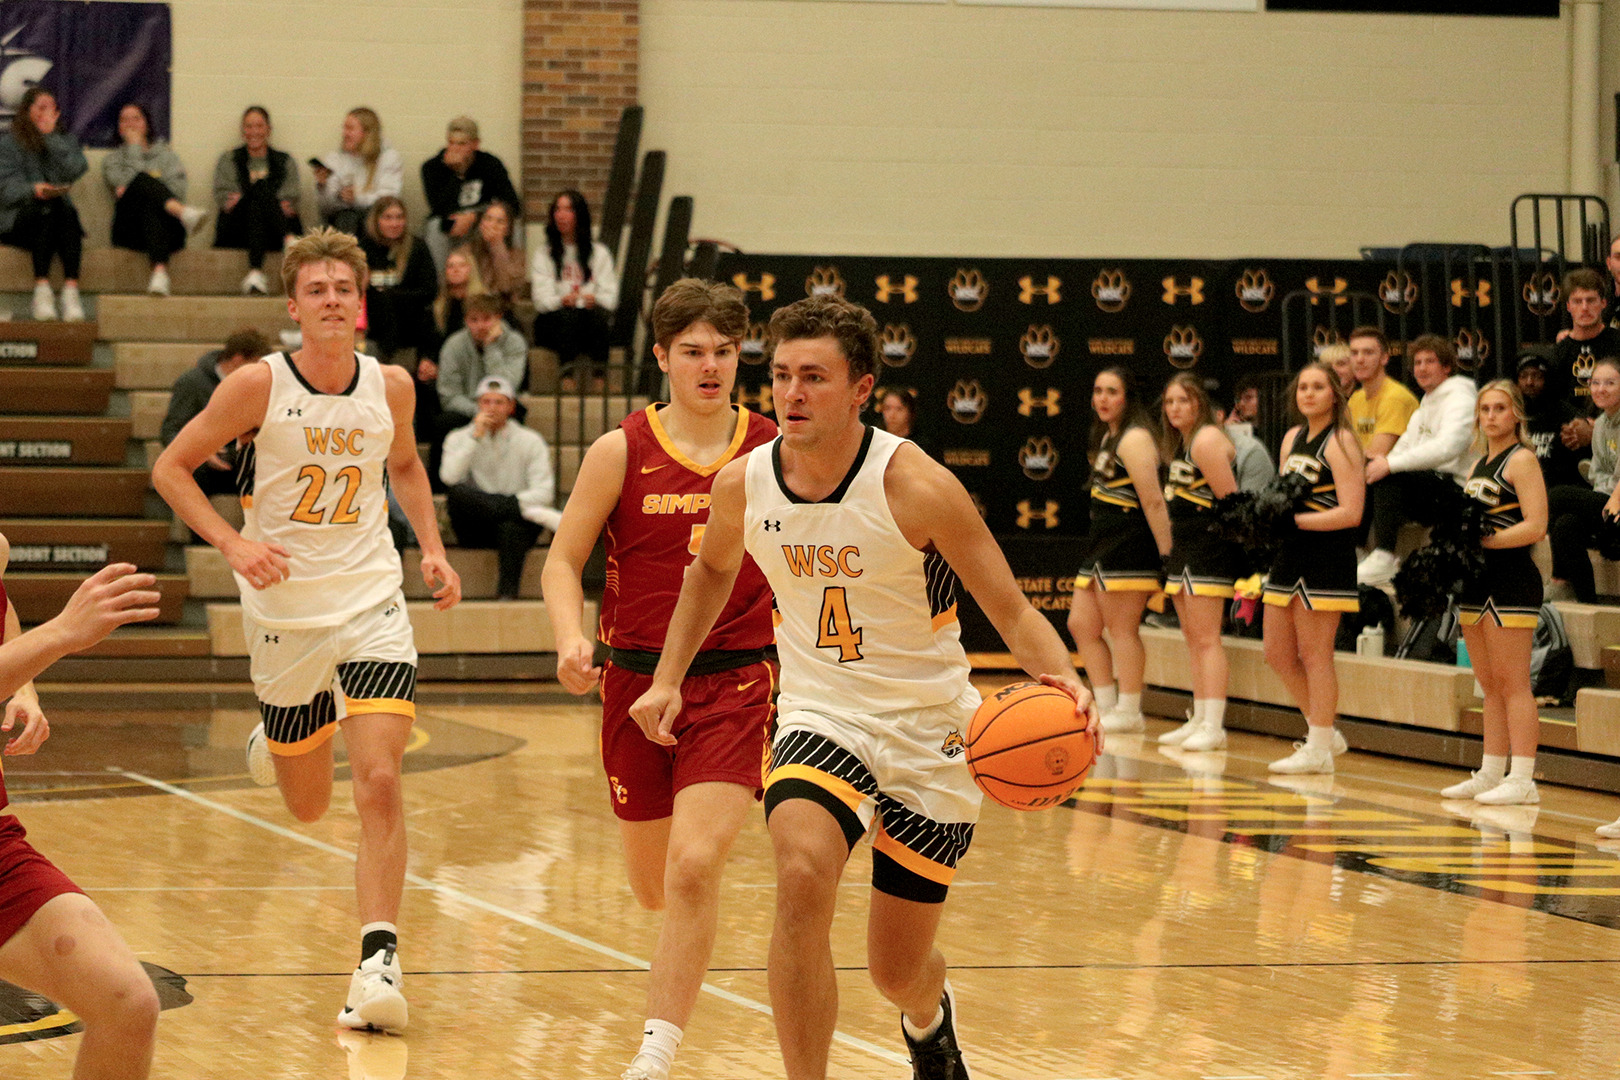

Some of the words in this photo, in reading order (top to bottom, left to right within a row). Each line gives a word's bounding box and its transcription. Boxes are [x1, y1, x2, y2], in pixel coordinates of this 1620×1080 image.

[303, 427, 364, 456] WSC
[289, 464, 362, 524] 22
[642, 493, 712, 514] SIMP
[781, 544, 863, 578] WSC
[816, 586, 864, 663] 4
